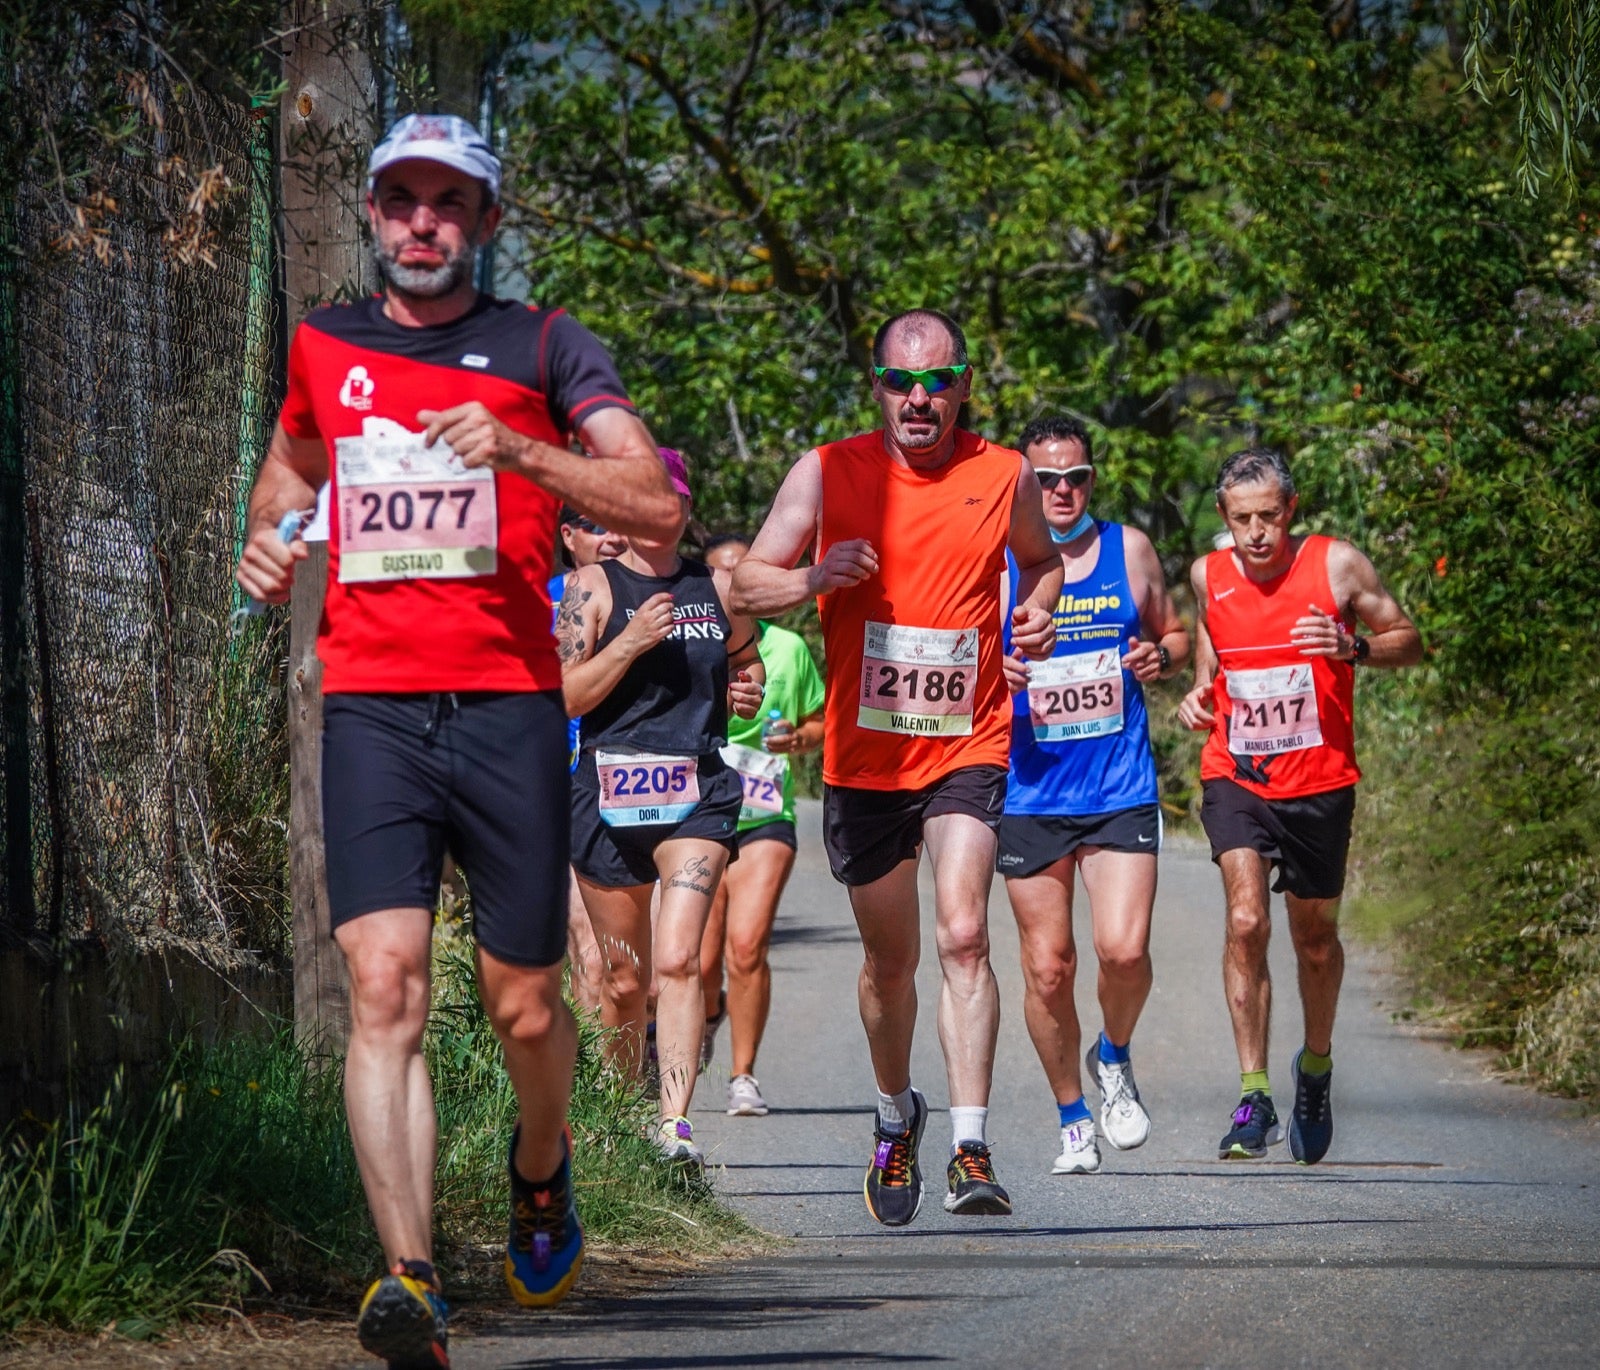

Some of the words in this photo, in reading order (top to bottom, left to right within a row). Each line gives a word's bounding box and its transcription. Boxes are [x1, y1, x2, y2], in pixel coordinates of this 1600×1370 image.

[360, 489, 476, 532] 2077
[382, 553, 443, 572] GUSTAVO
[1056, 594, 1121, 614] limpo
[1073, 632, 1080, 640] &
[1081, 629, 1119, 639] RUNNING
[864, 671, 873, 698] MASTER
[877, 666, 966, 702] 2186
[1045, 682, 1114, 715] 2053
[1243, 697, 1306, 727] 2117
[891, 714, 940, 731] VALENTIN
[1061, 725, 1081, 736] JUAN
[1083, 722, 1101, 734] LUIS
[1244, 740, 1275, 752] MANUEL
[1277, 735, 1304, 749] PABLO
[612, 766, 687, 796] 2205
[639, 808, 659, 821] DORI
